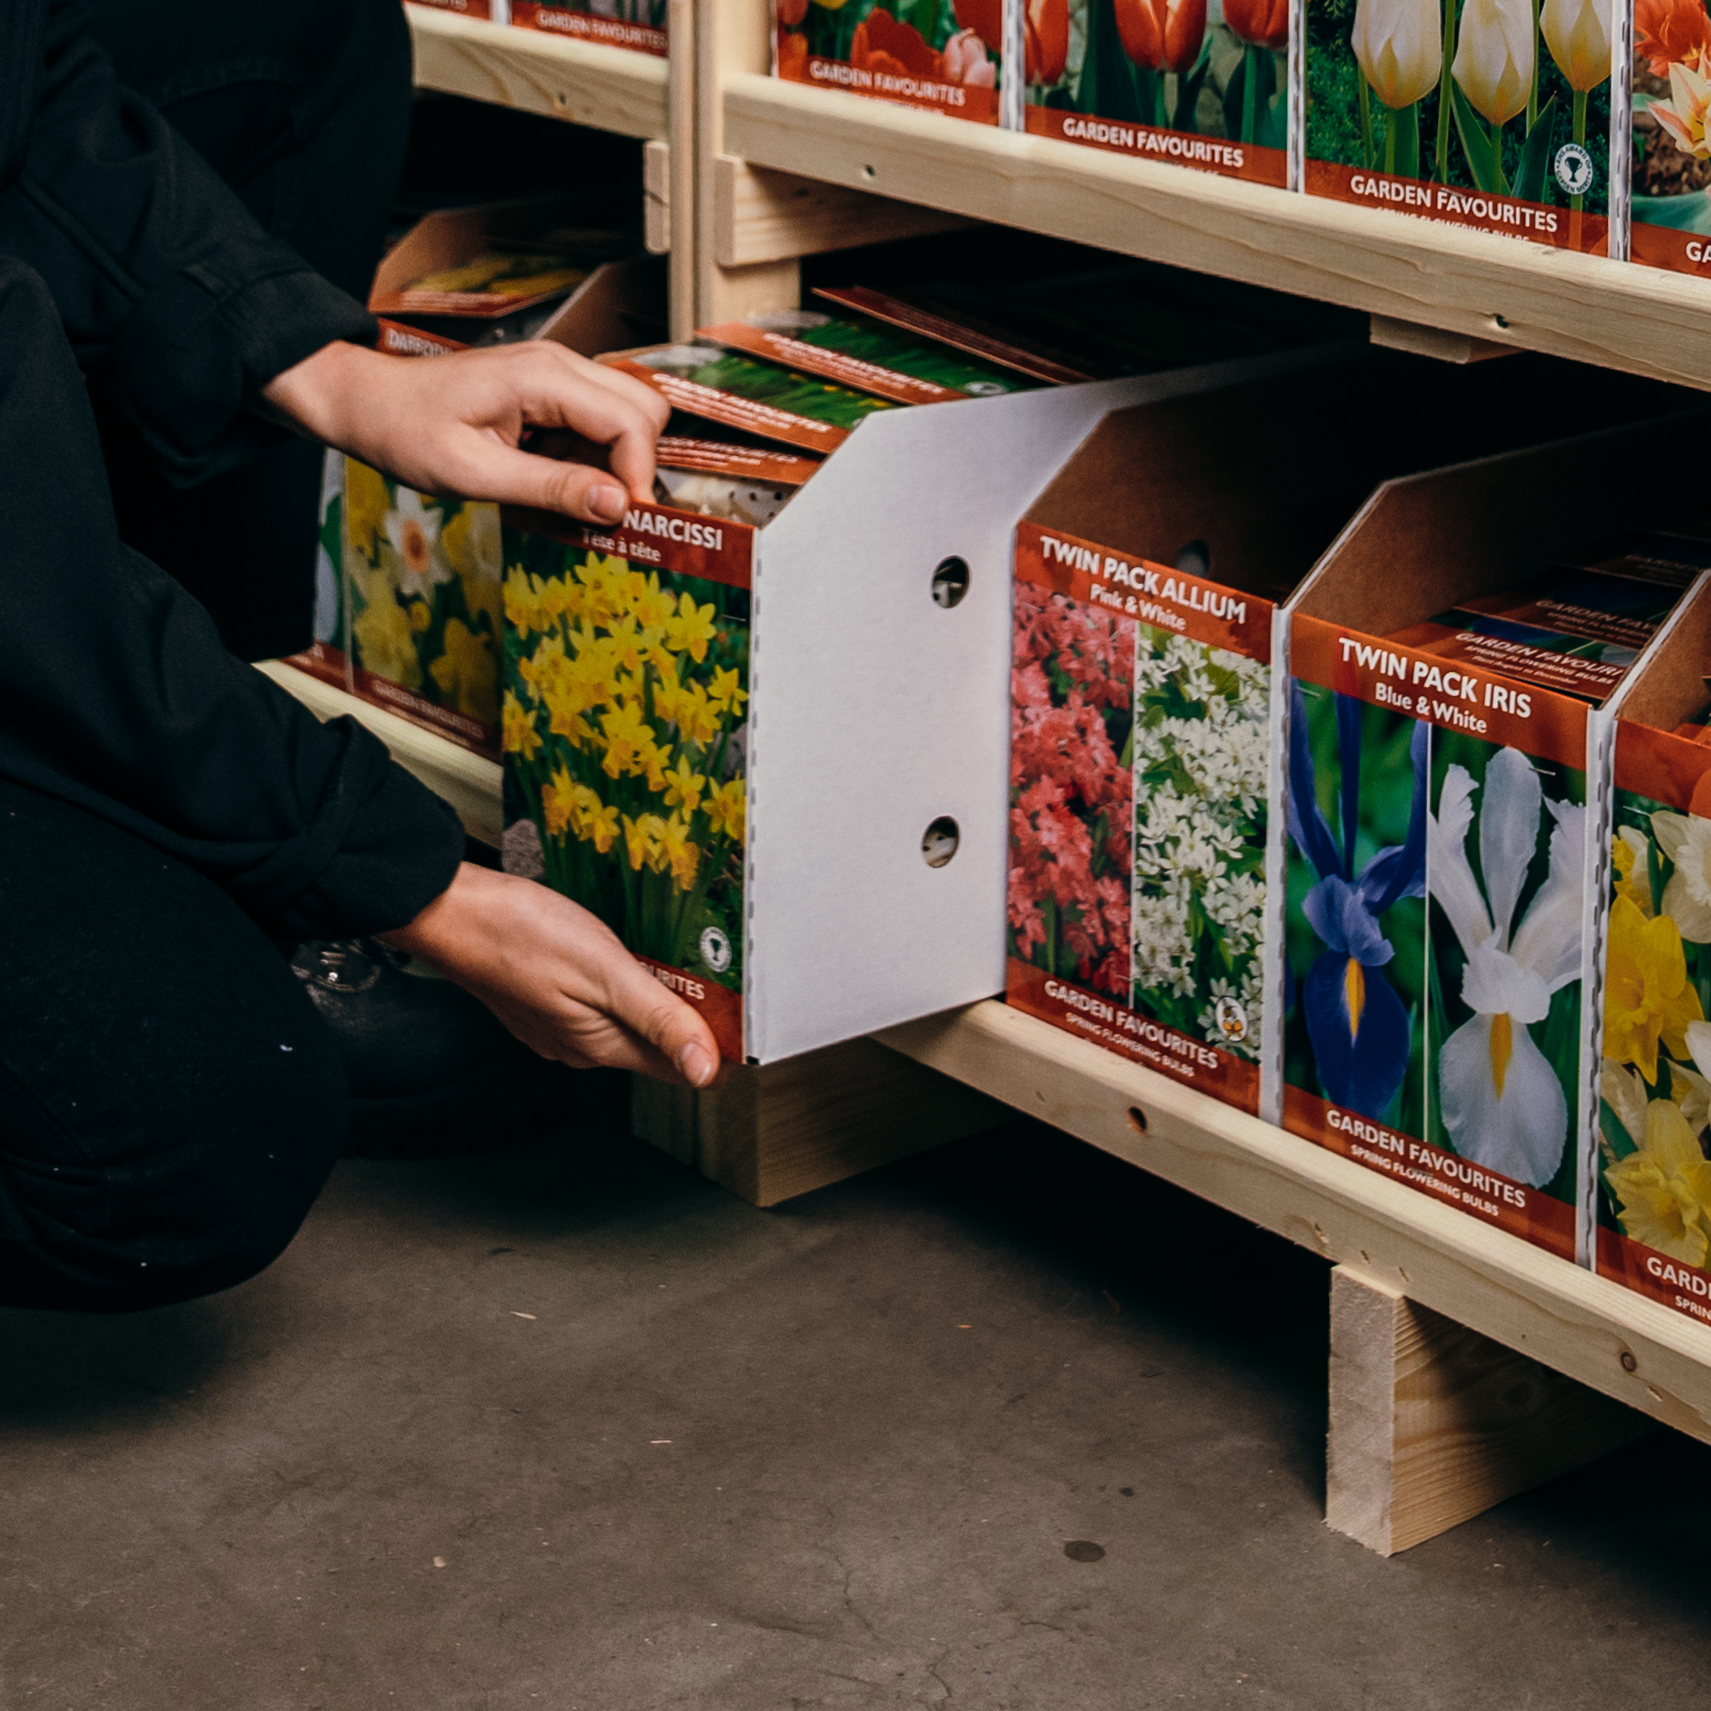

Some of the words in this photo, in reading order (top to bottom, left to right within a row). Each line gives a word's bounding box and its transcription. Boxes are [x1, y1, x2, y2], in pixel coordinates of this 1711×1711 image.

[810, 61, 872, 87] GARDEN
[874, 72, 965, 107] FAVOURITES
[1063, 117, 1133, 148] GARDEN
[1137, 131, 1243, 168] FAVOURITES
[1350, 175, 1431, 208] GARDEN
[1437, 191, 1558, 232] FAVOURITES
[621, 509, 723, 551] NARCISSI
[1039, 535, 1100, 573] TWIN
[1103, 557, 1158, 596] PACK
[1161, 576, 1247, 624] ALLIUM
[1089, 583, 1123, 610] Pink
[1124, 597, 1138, 616] &
[1138, 601, 1187, 632] White
[1338, 637, 1408, 680] TWIN
[1412, 660, 1480, 702] PACK
[1484, 683, 1532, 719] IRIS
[1538, 650, 1625, 677] FAVOURI
[1375, 683, 1413, 711] Blue
[1415, 696, 1431, 716] &
[1433, 700, 1488, 733] White
[1044, 980, 1114, 1022] GARDEN
[1116, 1011, 1218, 1069] FAVOURITES
[1326, 1109, 1405, 1156] GARDEN
[1408, 1139, 1527, 1208] FAVOURITES
[1350, 1143, 1392, 1171] SPRING
[1393, 1163, 1460, 1203] FLOWERING
[1461, 1191, 1500, 1217] BULBS
